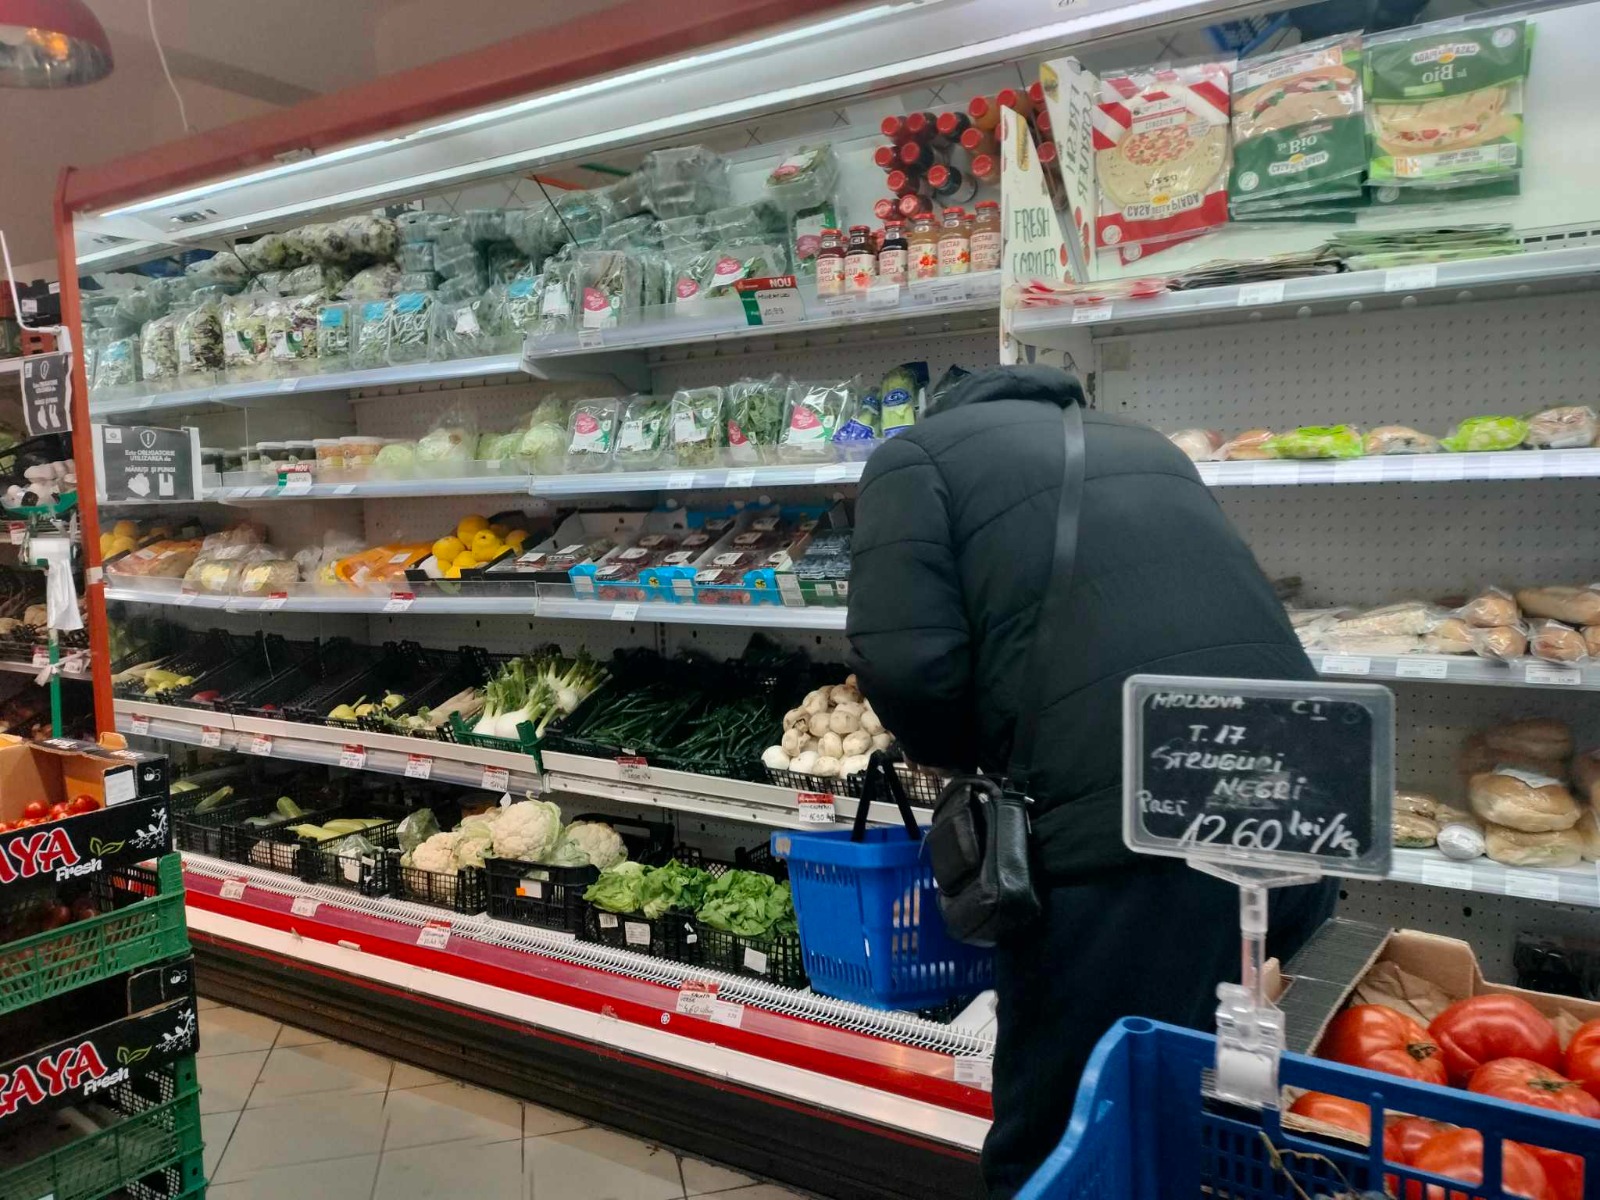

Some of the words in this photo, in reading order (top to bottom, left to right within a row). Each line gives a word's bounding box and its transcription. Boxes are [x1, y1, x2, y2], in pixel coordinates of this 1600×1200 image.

[1014, 207, 1050, 243] FRESH
[1013, 248, 1058, 283] CORNER
[769, 277, 792, 288] NOU
[1151, 691, 1246, 711] MOLDOVA
[56, 858, 103, 883] Fresh
[83, 1066, 130, 1096] Fresh
